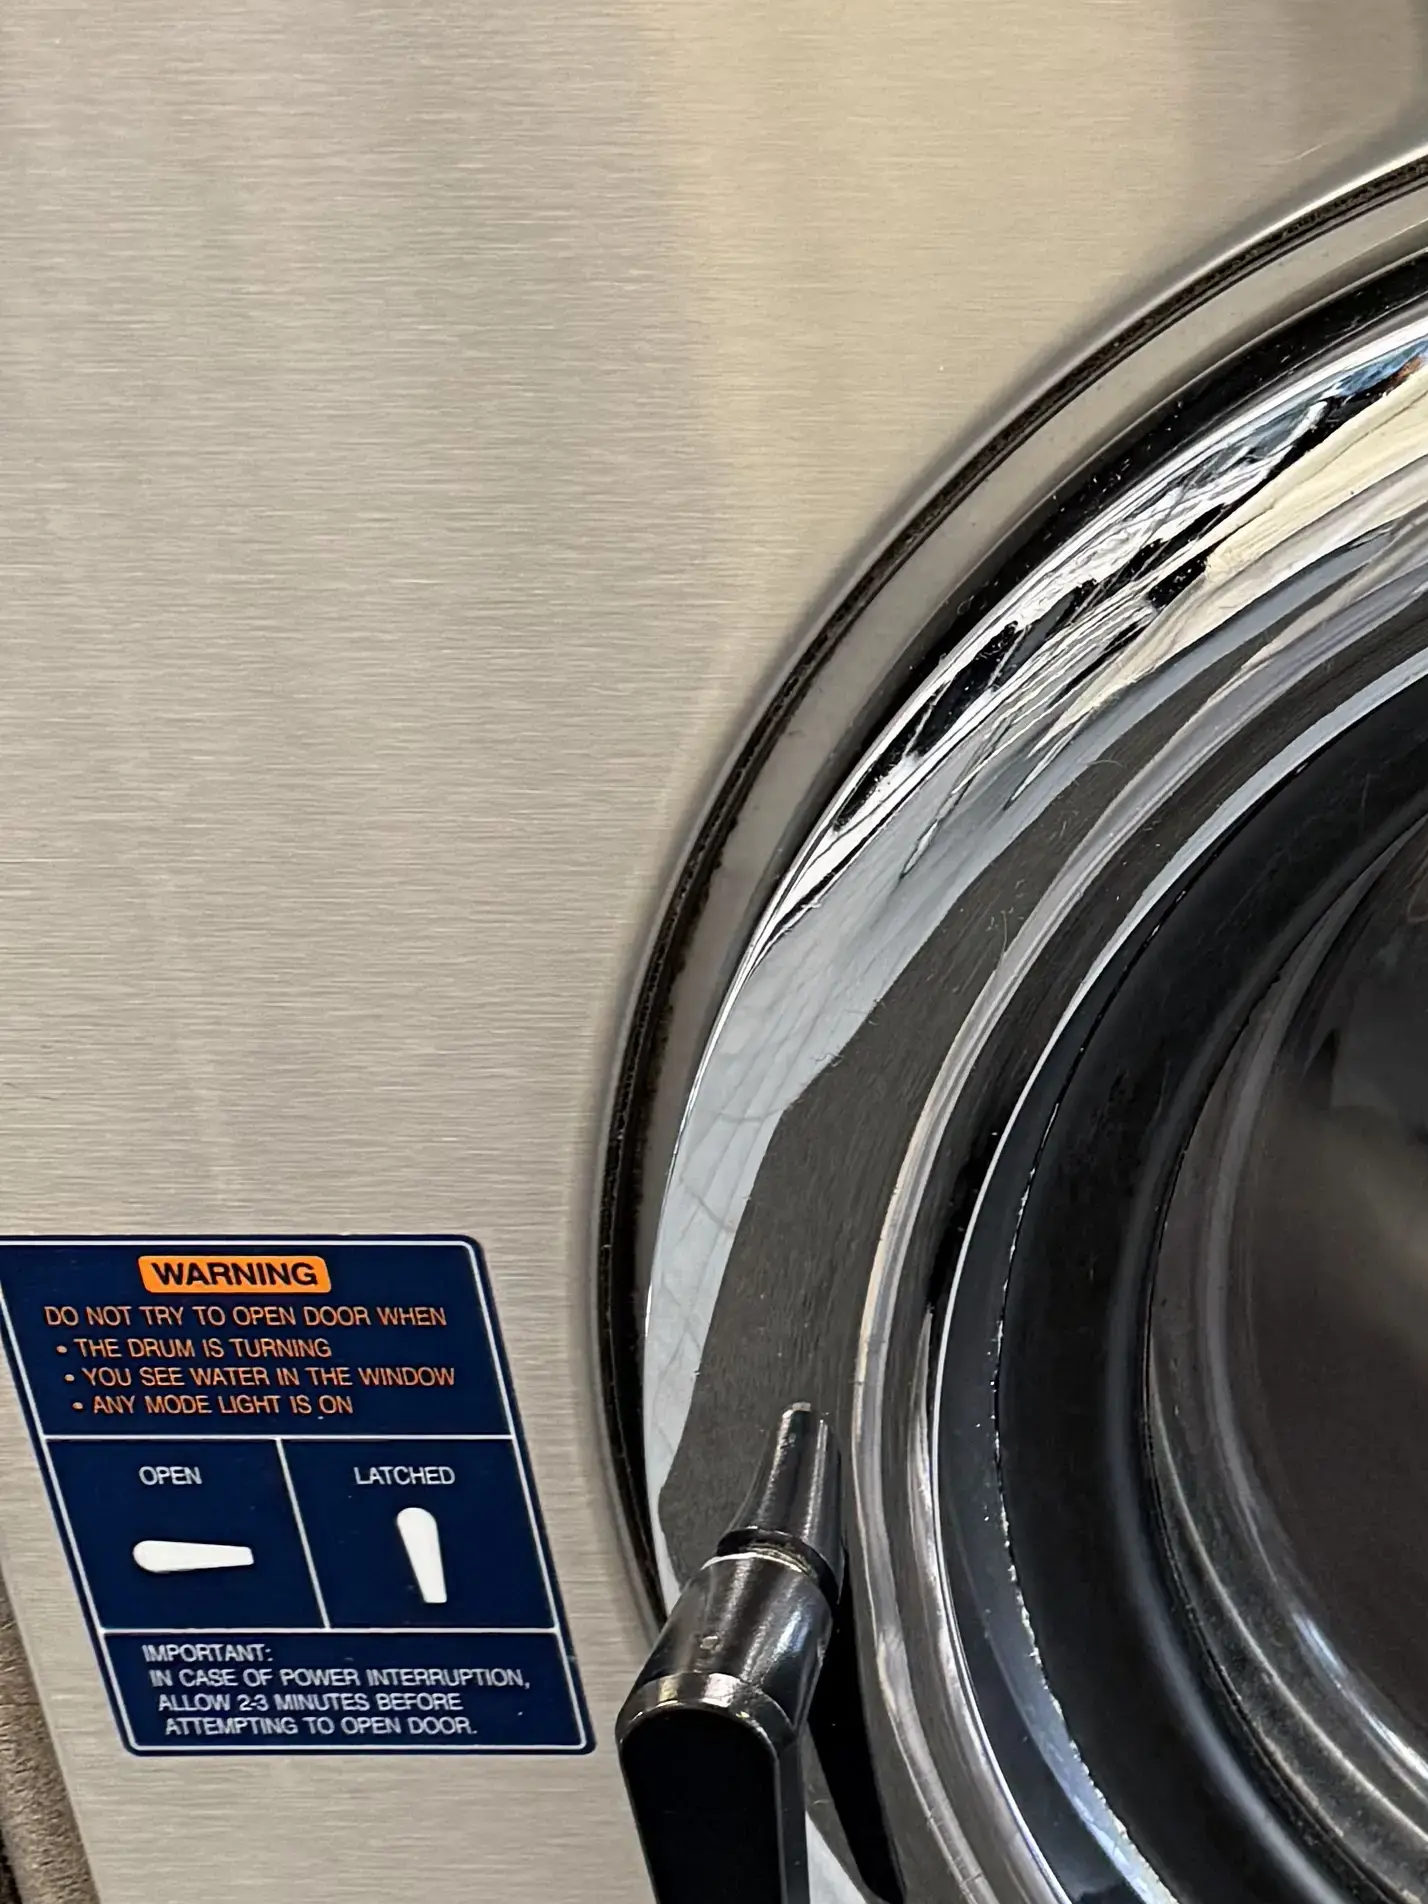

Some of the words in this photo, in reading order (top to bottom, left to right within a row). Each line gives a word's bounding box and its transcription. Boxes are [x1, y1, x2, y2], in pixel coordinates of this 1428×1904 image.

[151, 1261, 319, 1286] WARNING
[44, 1306, 80, 1326] DO
[87, 1306, 131, 1326] NOT
[140, 1306, 184, 1326] TRY
[193, 1306, 226, 1326] TO
[233, 1306, 296, 1326] OPEN
[304, 1306, 371, 1326] DOOR
[377, 1306, 447, 1327] WHEN
[74, 1339, 123, 1358] THE
[130, 1339, 195, 1358] DRUM
[203, 1339, 224, 1358] IS
[230, 1339, 332, 1358] TURNING
[82, 1368, 131, 1386] YOU
[141, 1368, 185, 1386] SEE
[189, 1368, 271, 1386] WATER
[277, 1368, 299, 1386] IN
[307, 1368, 352, 1386] THE
[358, 1368, 455, 1386] WINDOW
[93, 1396, 136, 1414] ANY
[145, 1396, 212, 1414] MODE
[219, 1396, 281, 1414] LIGHT
[290, 1396, 312, 1414] IS
[318, 1396, 353, 1414] ON
[139, 1466, 202, 1486] OPEN
[354, 1466, 456, 1486] LATCHED
[142, 1644, 274, 1663] IMPORTANT:
[150, 1669, 173, 1687] IN
[178, 1669, 238, 1687] CASE
[243, 1669, 274, 1687] OF
[280, 1669, 360, 1687] POWER
[367, 1669, 530, 1690] INTERRUPTION,
[158, 1693, 233, 1712] ALLOW
[239, 1693, 269, 1712] 2-3
[275, 1693, 371, 1712] MINUTES
[376, 1693, 464, 1712] BEFORE
[165, 1717, 298, 1736] ATTEMPTING
[302, 1717, 334, 1736] TO
[341, 1717, 402, 1736] OPEN
[408, 1717, 478, 1736] DOOR.
